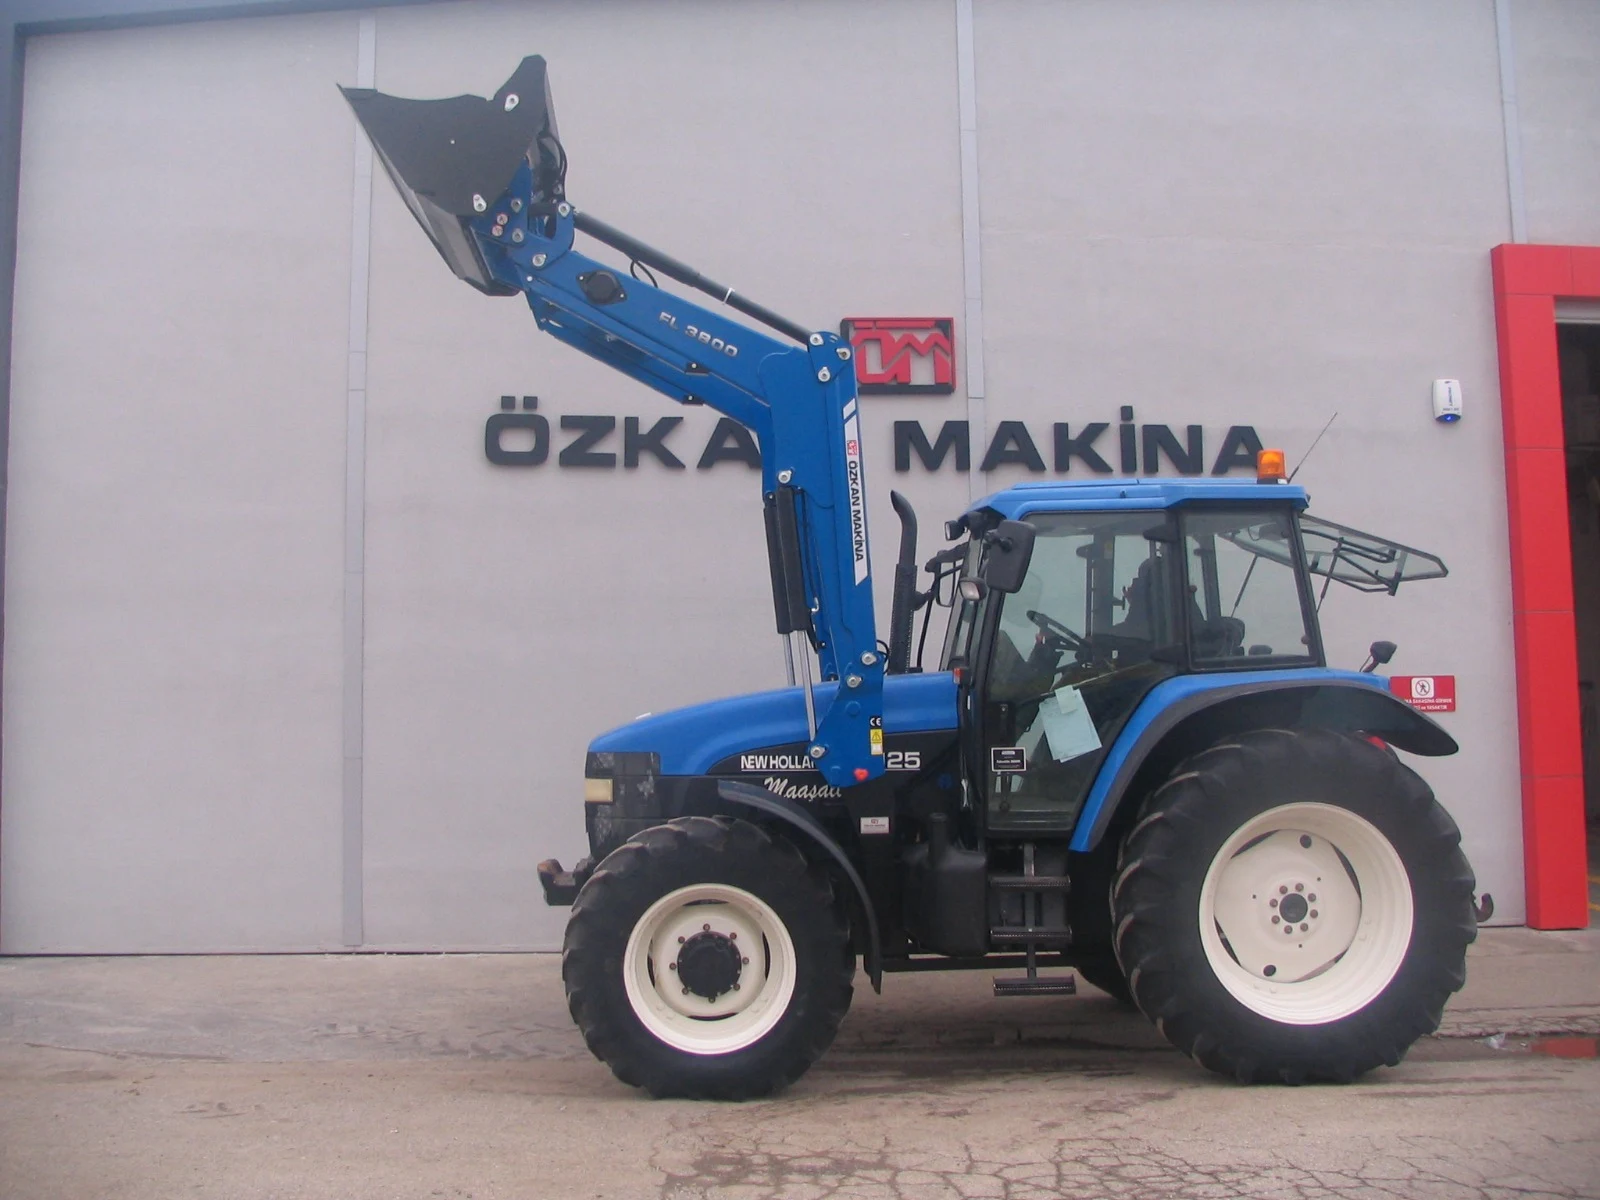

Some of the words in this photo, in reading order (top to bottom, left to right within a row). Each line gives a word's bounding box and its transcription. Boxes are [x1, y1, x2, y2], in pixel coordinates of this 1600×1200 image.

[659, 311, 679, 330] FL
[684, 325, 738, 357] 3800
[484, 396, 763, 469] ÖZKA
[894, 405, 1264, 475] MAKİNA
[848, 460, 860, 506] ÖZKAN
[852, 509, 865, 562] MAKİNA
[741, 755, 767, 769] NEW
[769, 755, 815, 769] HOLLA
[883, 751, 921, 769] 25
